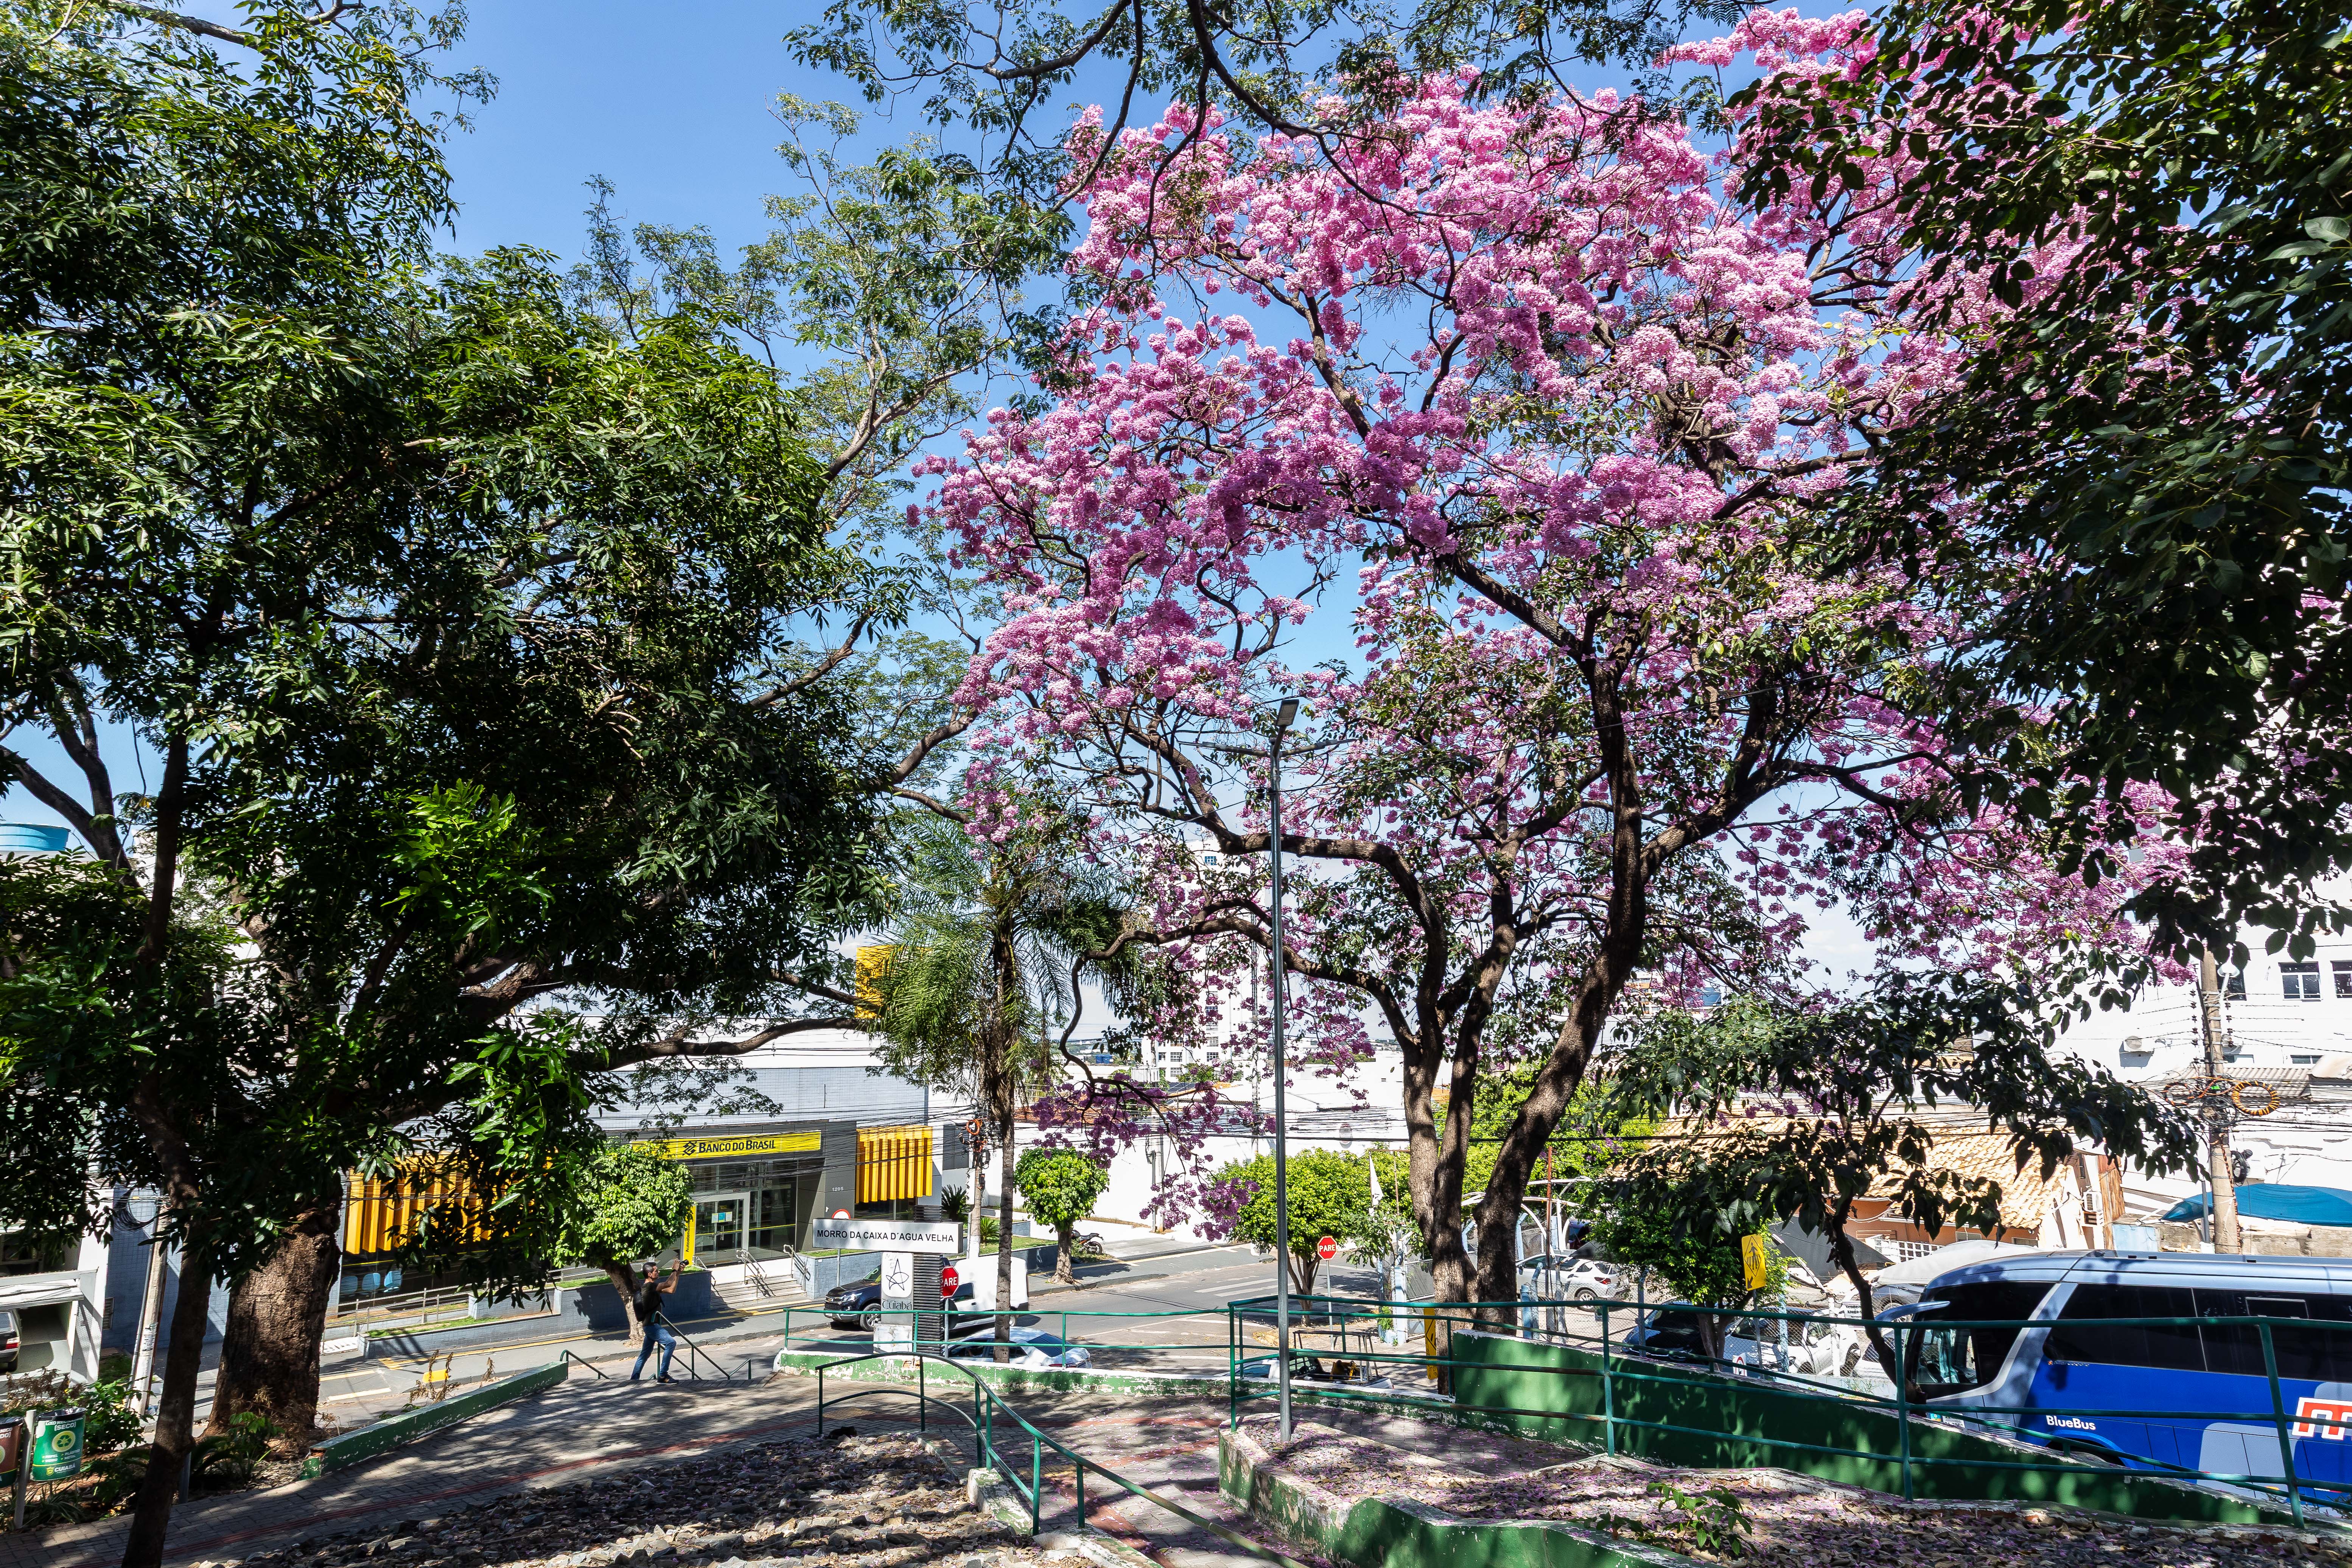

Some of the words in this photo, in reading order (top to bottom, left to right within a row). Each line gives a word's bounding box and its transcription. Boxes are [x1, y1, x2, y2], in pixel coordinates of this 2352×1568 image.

[699, 1142, 731, 1153] BANCO
[733, 1142, 744, 1151] DO
[746, 1139, 776, 1150] BRASIL
[817, 1230, 848, 1238] MORRO
[863, 1231, 888, 1240] CAIXA
[925, 1234, 954, 1242] VELHA
[1319, 1244, 1336, 1252] PARE
[942, 1276, 957, 1287] ARE
[882, 1300, 912, 1310] Cuiabá
[2046, 1415, 2096, 1430] BlueBus
[54, 1462, 76, 1472] CUIABÁ
